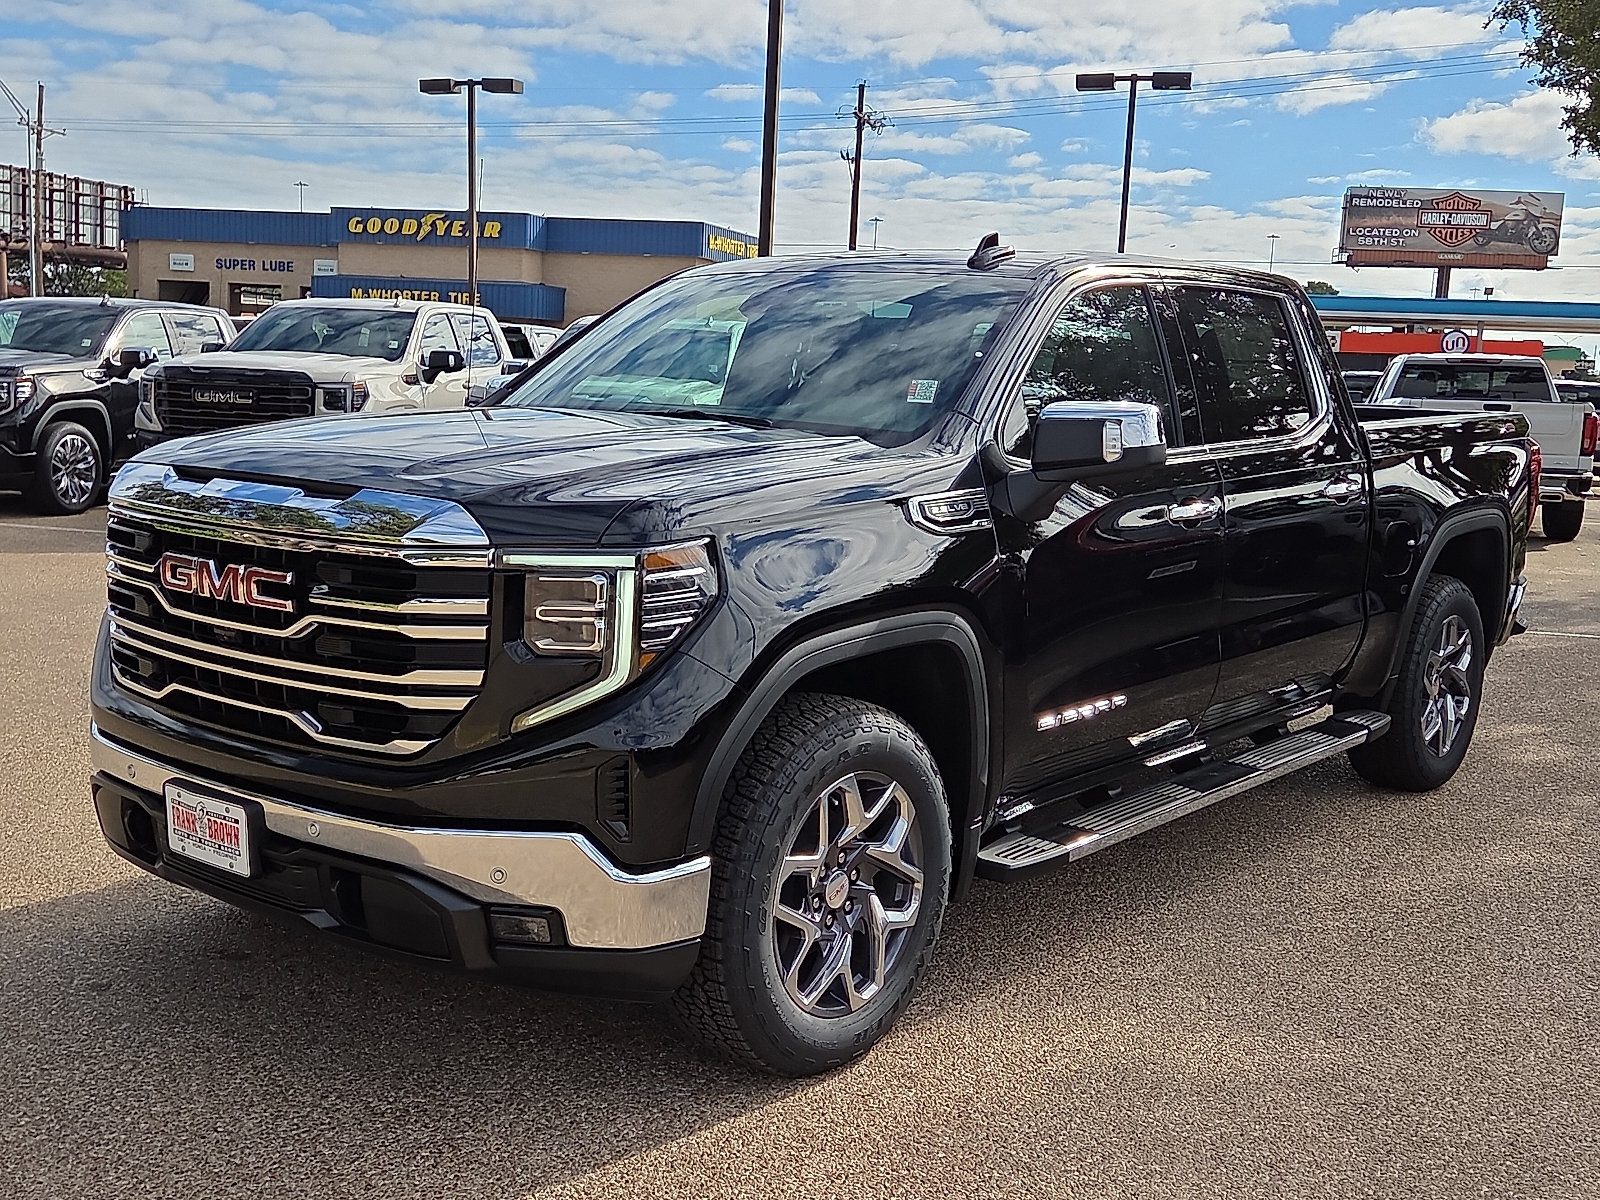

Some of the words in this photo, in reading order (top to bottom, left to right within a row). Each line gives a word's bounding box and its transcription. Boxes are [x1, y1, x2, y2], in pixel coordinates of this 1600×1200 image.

[1369, 189, 1407, 198] NEWLY
[1352, 198, 1421, 208] REMODELED
[1438, 199, 1474, 210] MOTOR
[1421, 212, 1488, 226] HARLEY-DAVIDSON
[1349, 227, 1400, 236] LOCATED
[1402, 229, 1419, 237] ON
[1435, 228, 1470, 243] CYCLES
[1357, 236, 1388, 246] 58TH
[1390, 238, 1406, 247] ST.
[215, 258, 256, 271] SUPER
[262, 260, 294, 273] LUBE
[448, 292, 481, 306] TIRE
[194, 389, 253, 404] GMC
[161, 552, 293, 612] GMC
[1037, 693, 1128, 731] SIERRA
[171, 804, 199, 836] FRANK
[206, 817, 240, 850] BROWN
[829, 878, 848, 901] GMC
